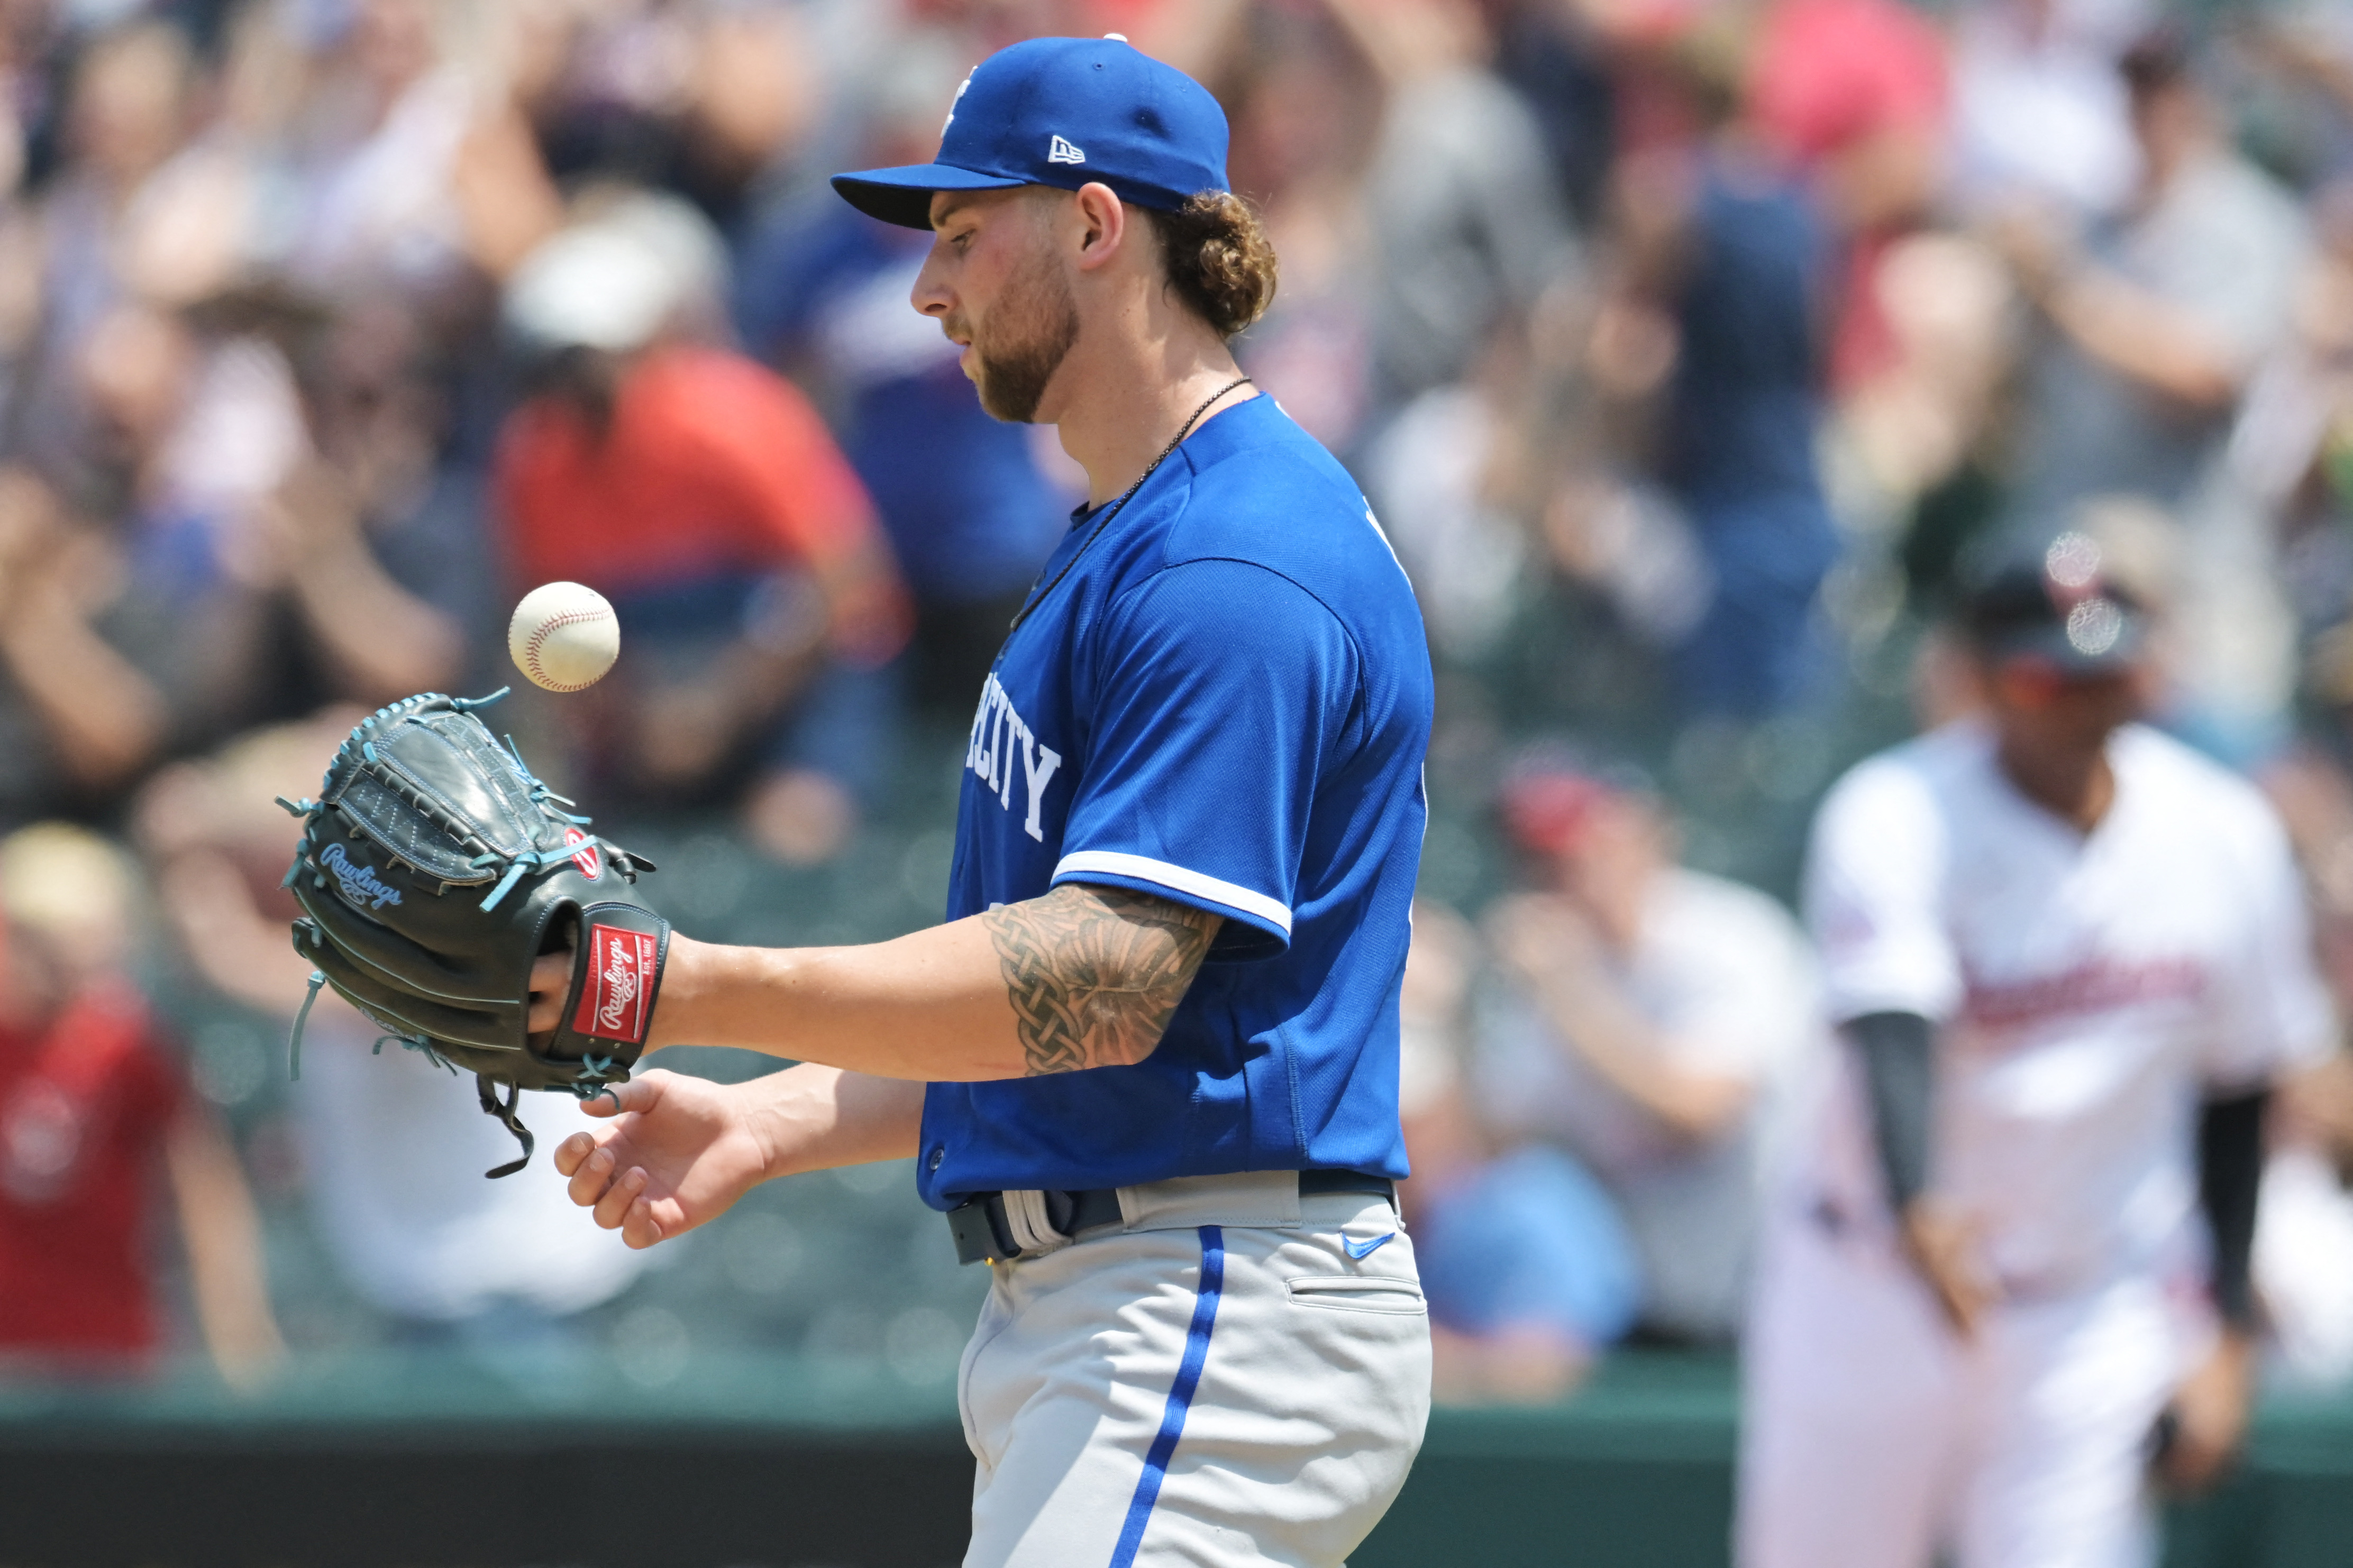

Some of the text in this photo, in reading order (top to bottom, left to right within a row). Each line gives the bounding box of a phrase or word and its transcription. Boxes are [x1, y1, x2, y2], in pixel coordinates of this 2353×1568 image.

[974, 672, 1061, 842] CITY
[320, 843, 403, 910] Rawlings
[599, 938, 633, 1030] Rawlings
[643, 939, 651, 957] 1887
